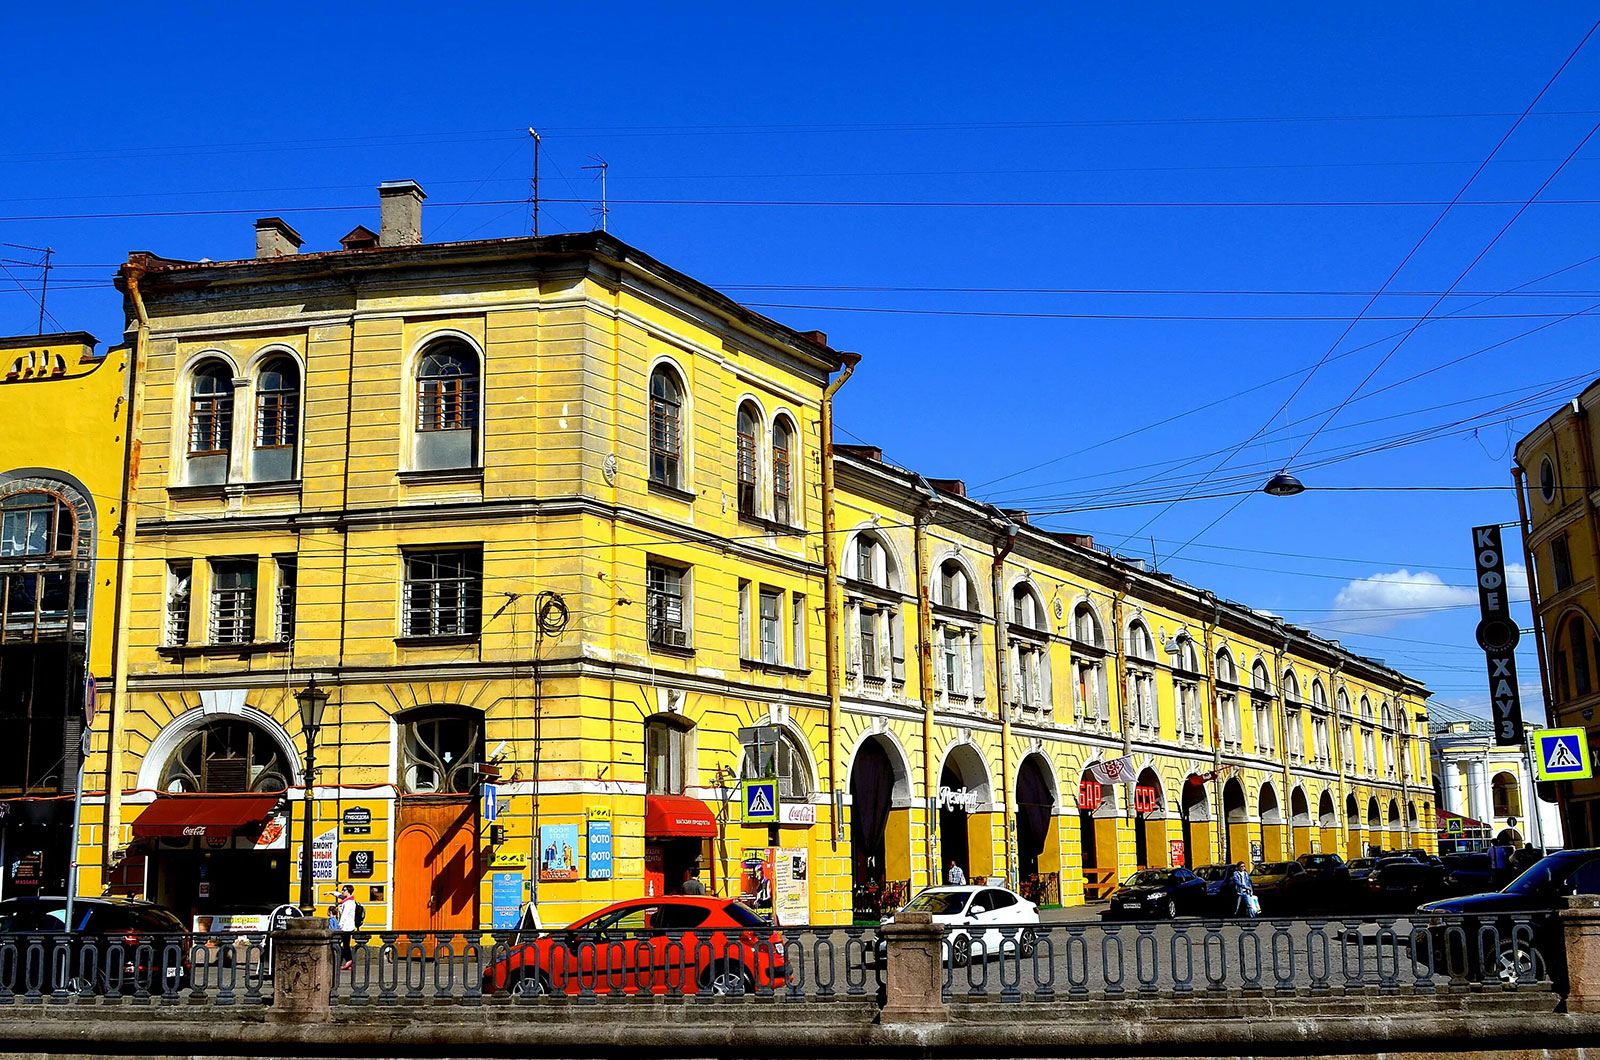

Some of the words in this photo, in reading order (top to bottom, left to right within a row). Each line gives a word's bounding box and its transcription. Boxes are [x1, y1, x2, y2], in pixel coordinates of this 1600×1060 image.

[1476, 528, 1502, 611] КОФЕ
[1492, 658, 1515, 739] ХАУЗ
[940, 786, 978, 812] Resident
[1079, 781, 1102, 809] БАР
[591, 834, 610, 843] ФОТО
[298, 861, 332, 869] НБУКОВ
[591, 851, 611, 861] ФОТО
[591, 869, 611, 878] ФОТО
